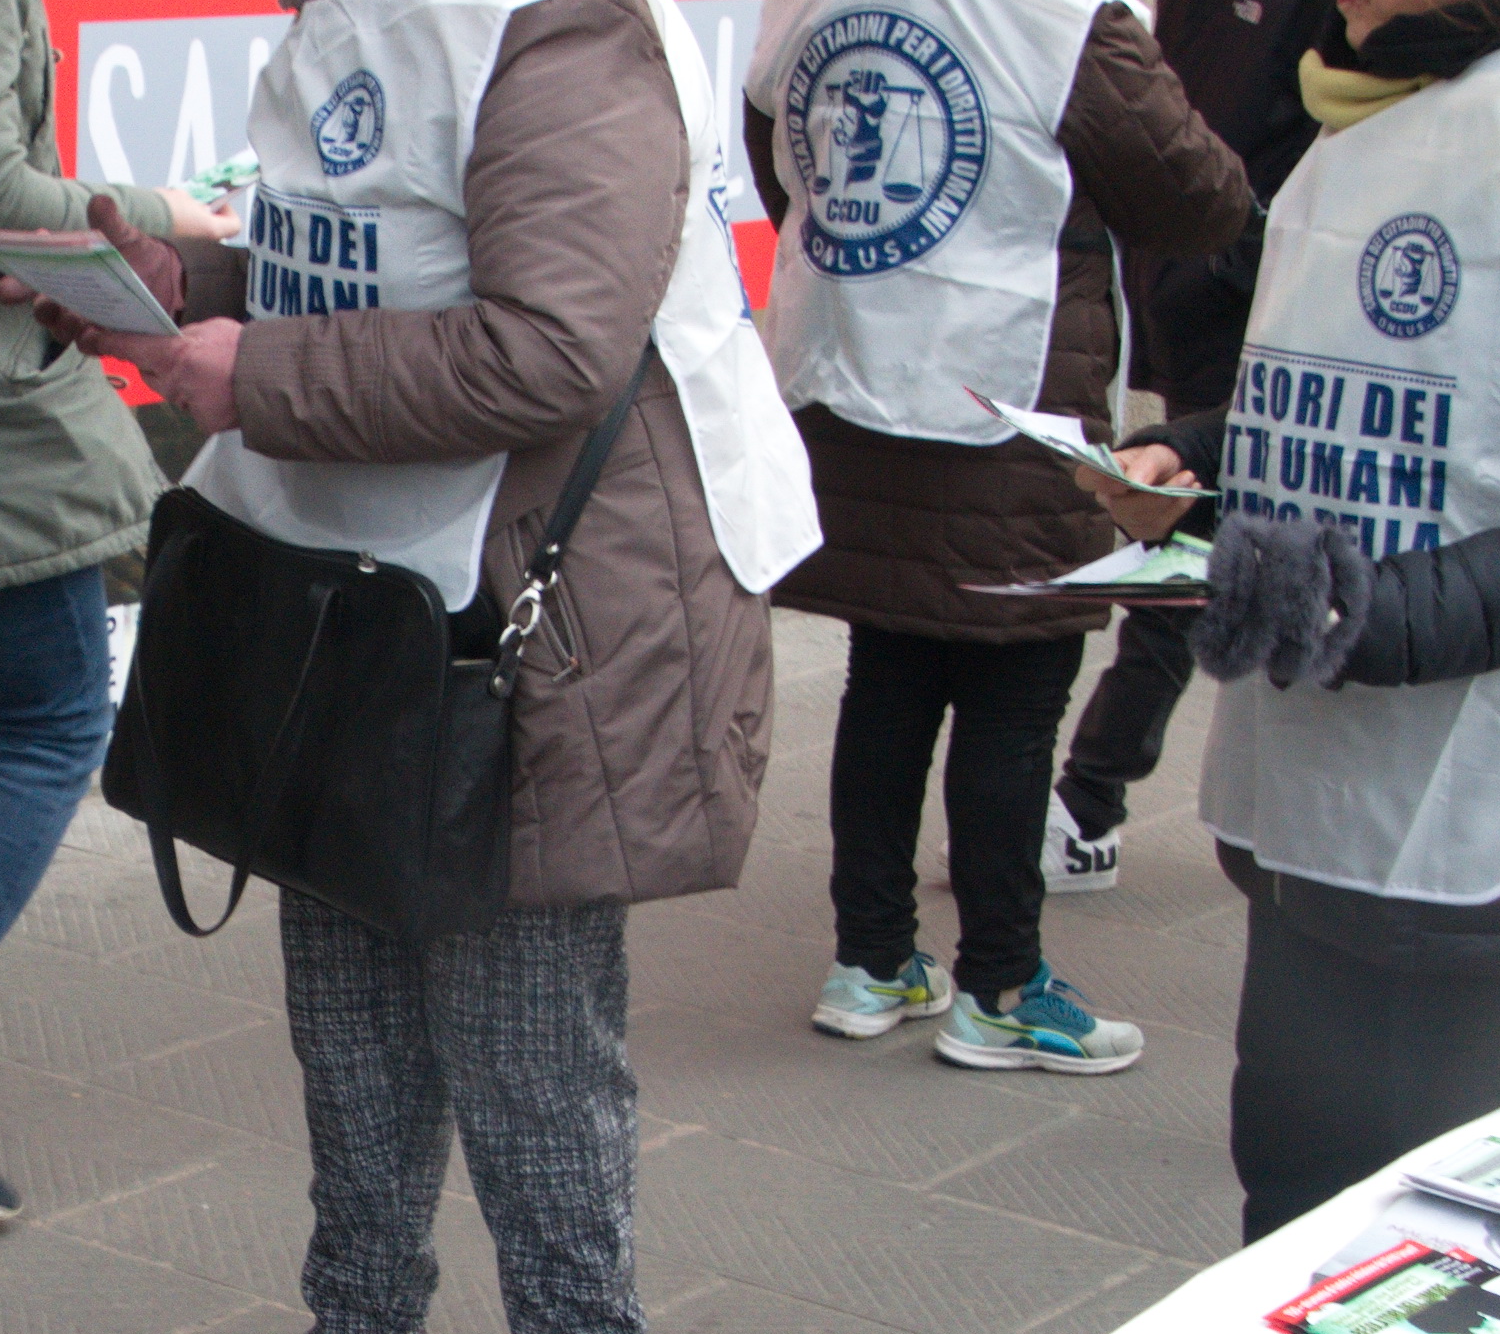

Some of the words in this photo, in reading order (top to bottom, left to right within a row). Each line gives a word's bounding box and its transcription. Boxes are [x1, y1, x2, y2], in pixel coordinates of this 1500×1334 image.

[801, 13, 890, 71] CITTADINI
[887, 20, 939, 64] PER
[929, 55, 953, 76] I
[937, 69, 985, 155] DIRITTI
[919, 158, 980, 239] UMANI
[309, 213, 378, 273] DEI
[260, 259, 380, 318] UMANI
[1360, 382, 1452, 449] DEI
[1279, 436, 1447, 513] UMANI
